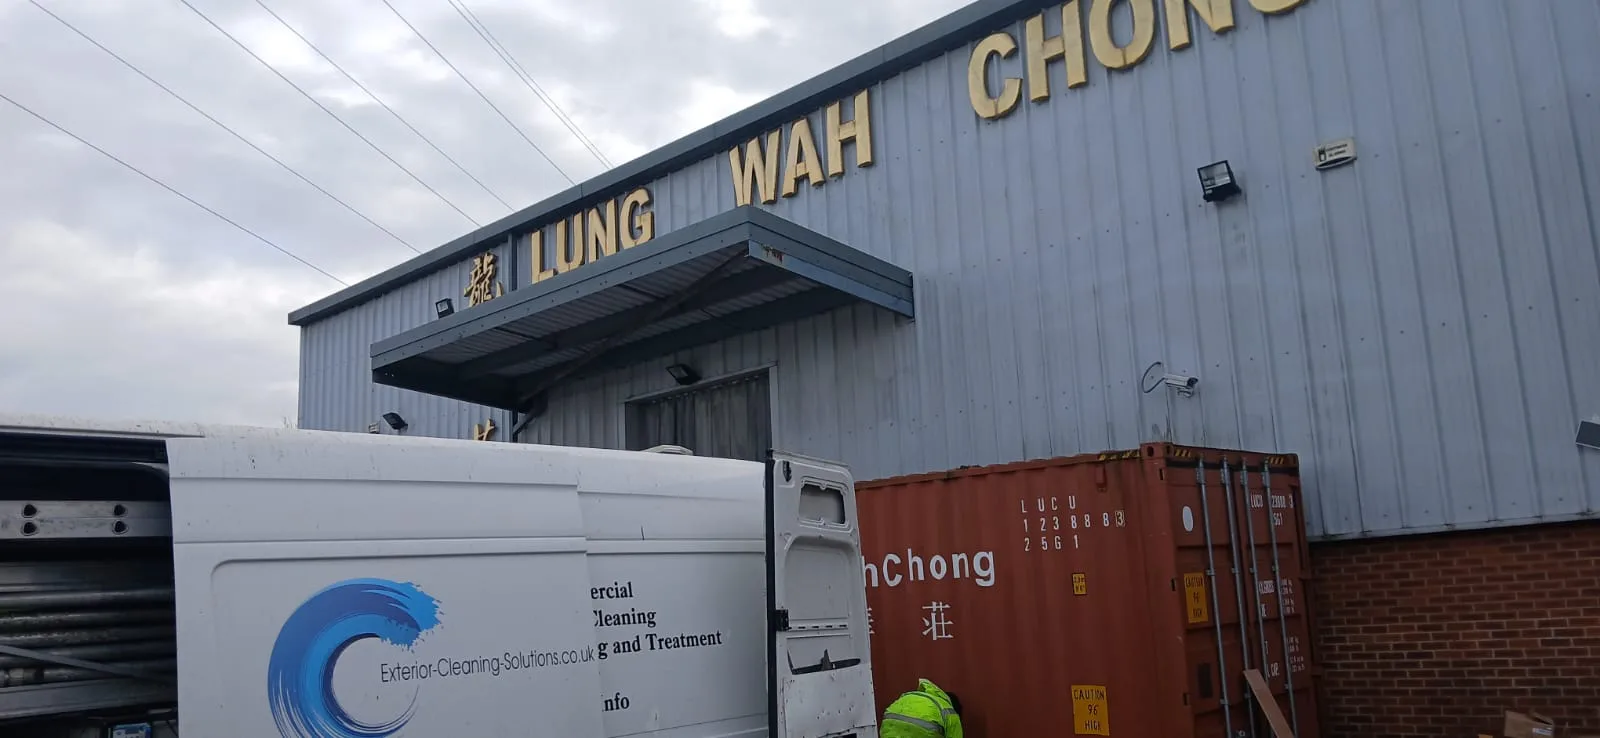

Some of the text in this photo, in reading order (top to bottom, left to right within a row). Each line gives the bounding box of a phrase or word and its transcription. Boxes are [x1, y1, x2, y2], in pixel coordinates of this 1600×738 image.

[531, 0, 1308, 285] LUNG WAH CHON
[612, 634, 642, 654] and
[645, 630, 723, 651] Treatment
[380, 644, 596, 683] Exterior-Cleaning-Solutions.co.uk
[601, 691, 630, 712] nfo
